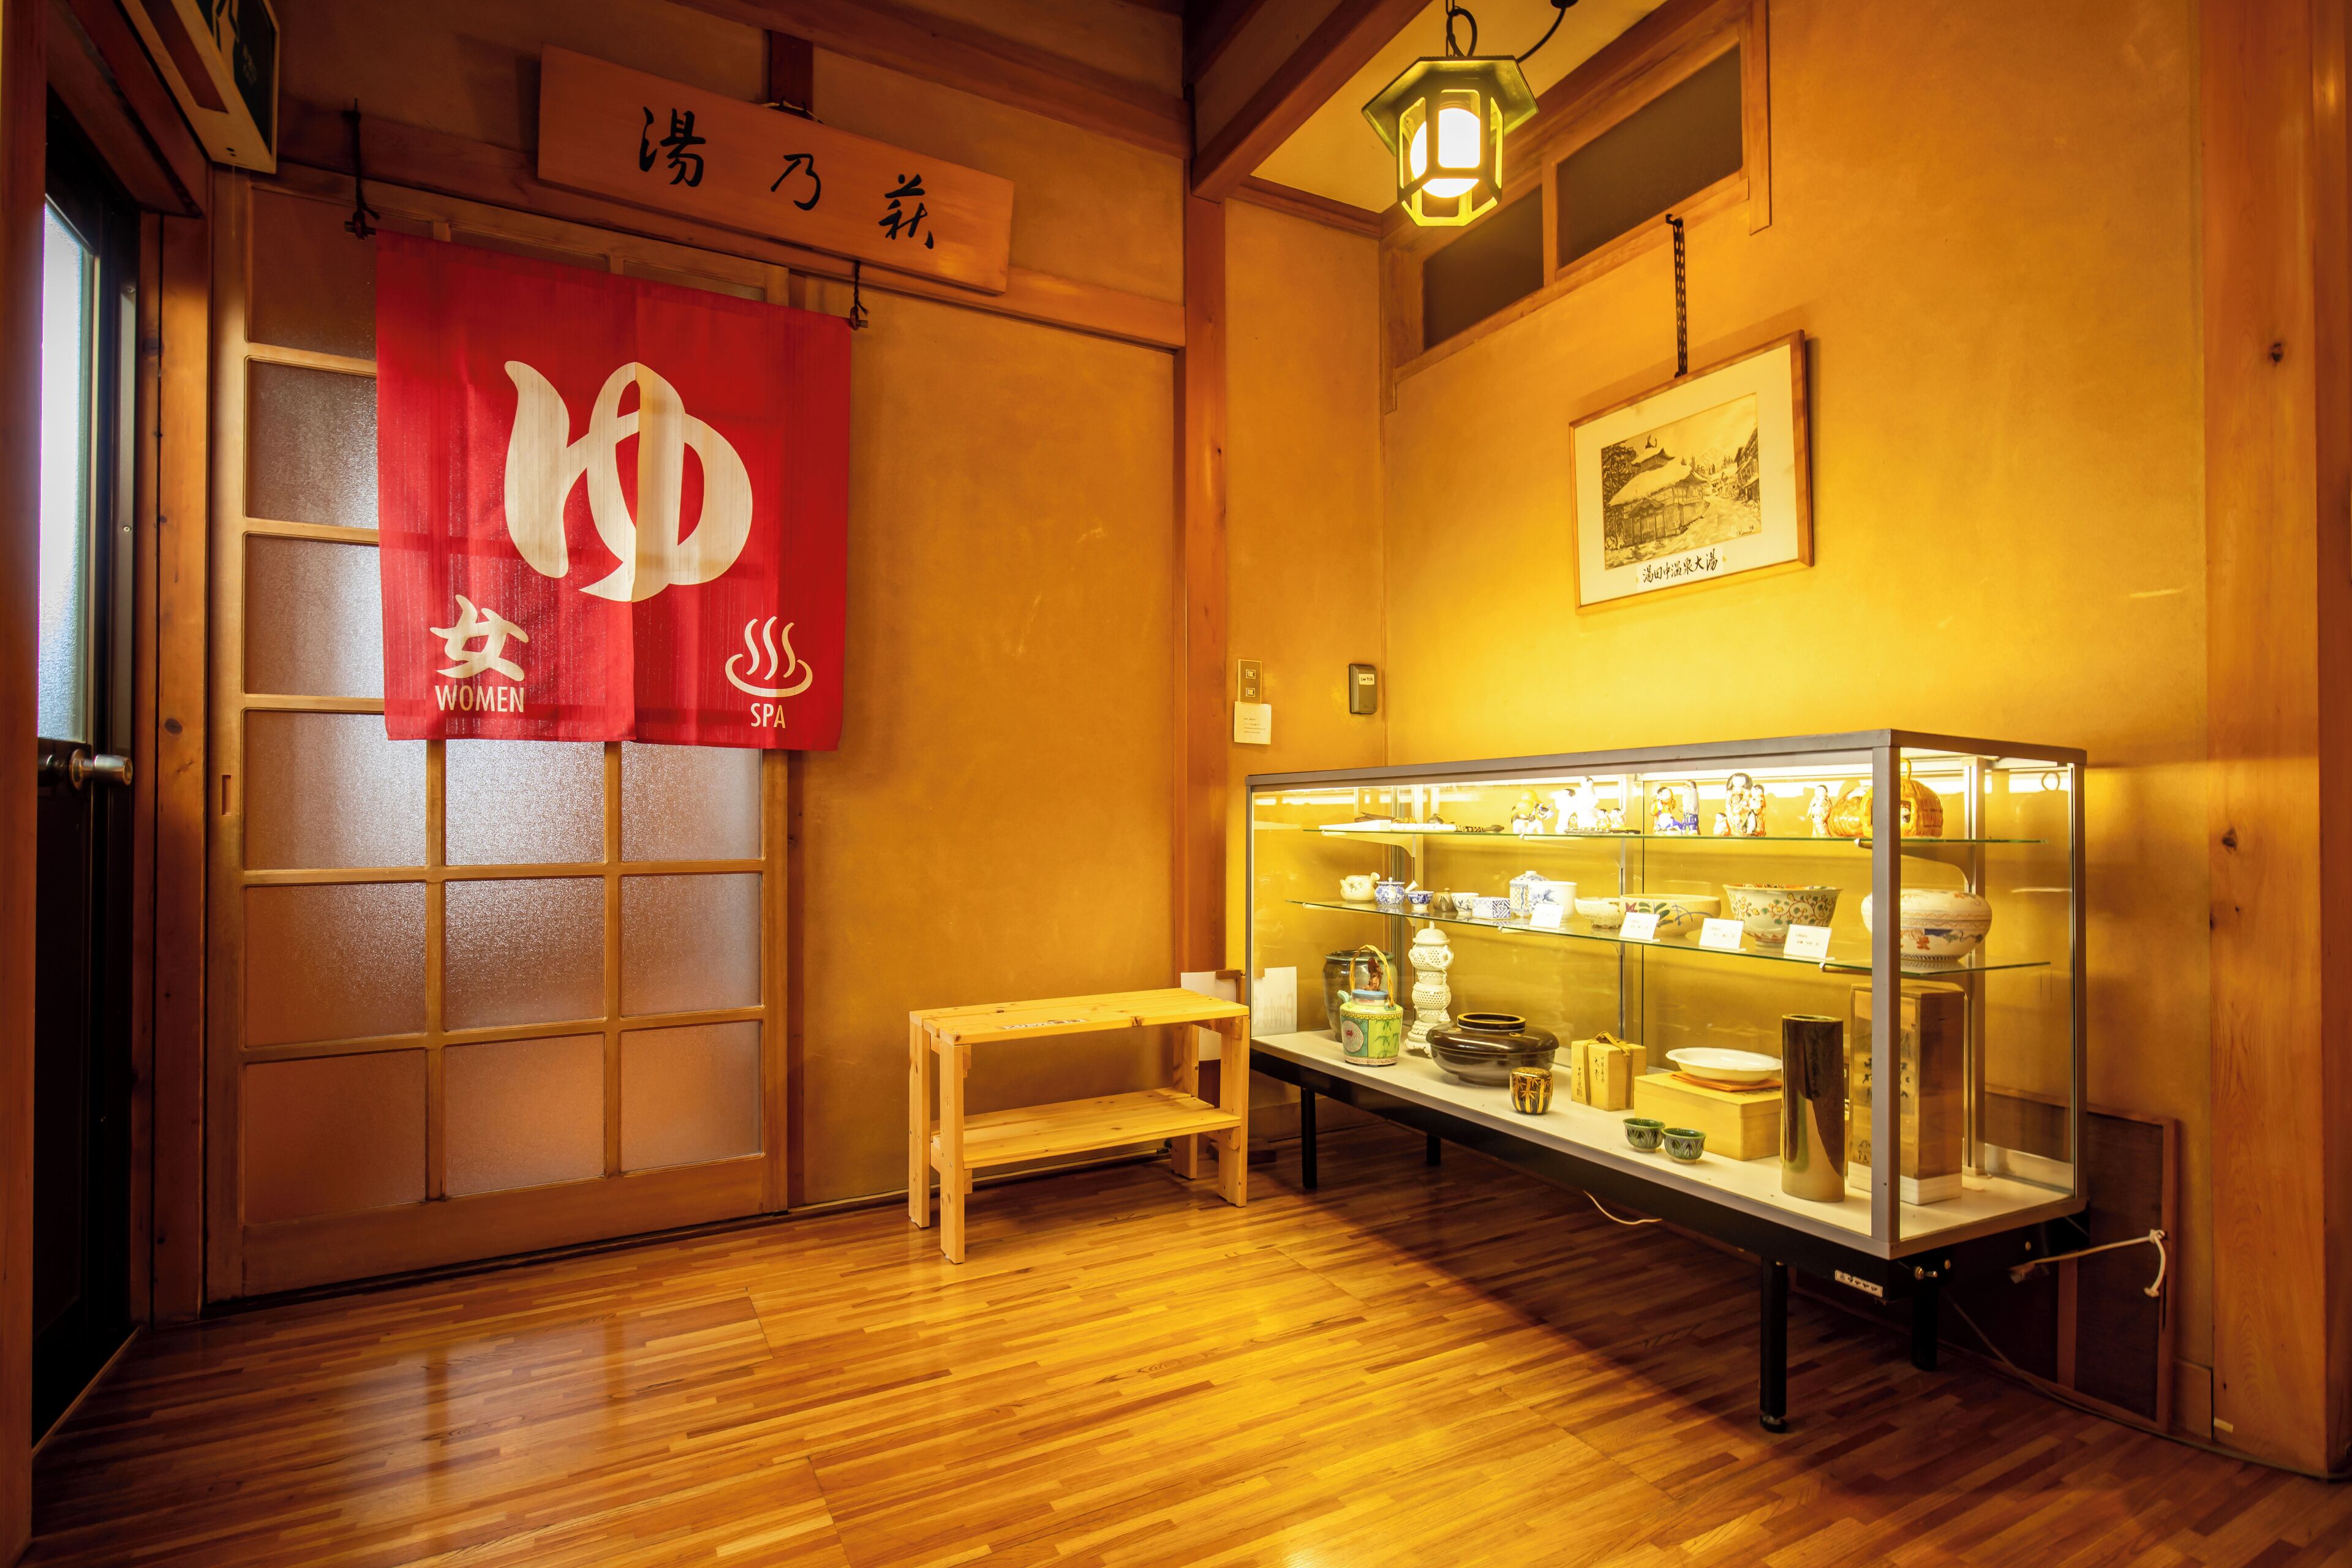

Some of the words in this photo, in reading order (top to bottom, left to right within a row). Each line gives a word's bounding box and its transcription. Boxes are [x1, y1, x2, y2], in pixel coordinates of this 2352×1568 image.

[503, 360, 753, 603] ゆ
[1642, 548, 1719, 584] 湯田中温泉大湯
[429, 594, 529, 682] 女
[435, 685, 525, 713] WOMEN
[750, 703, 786, 729] SPA
